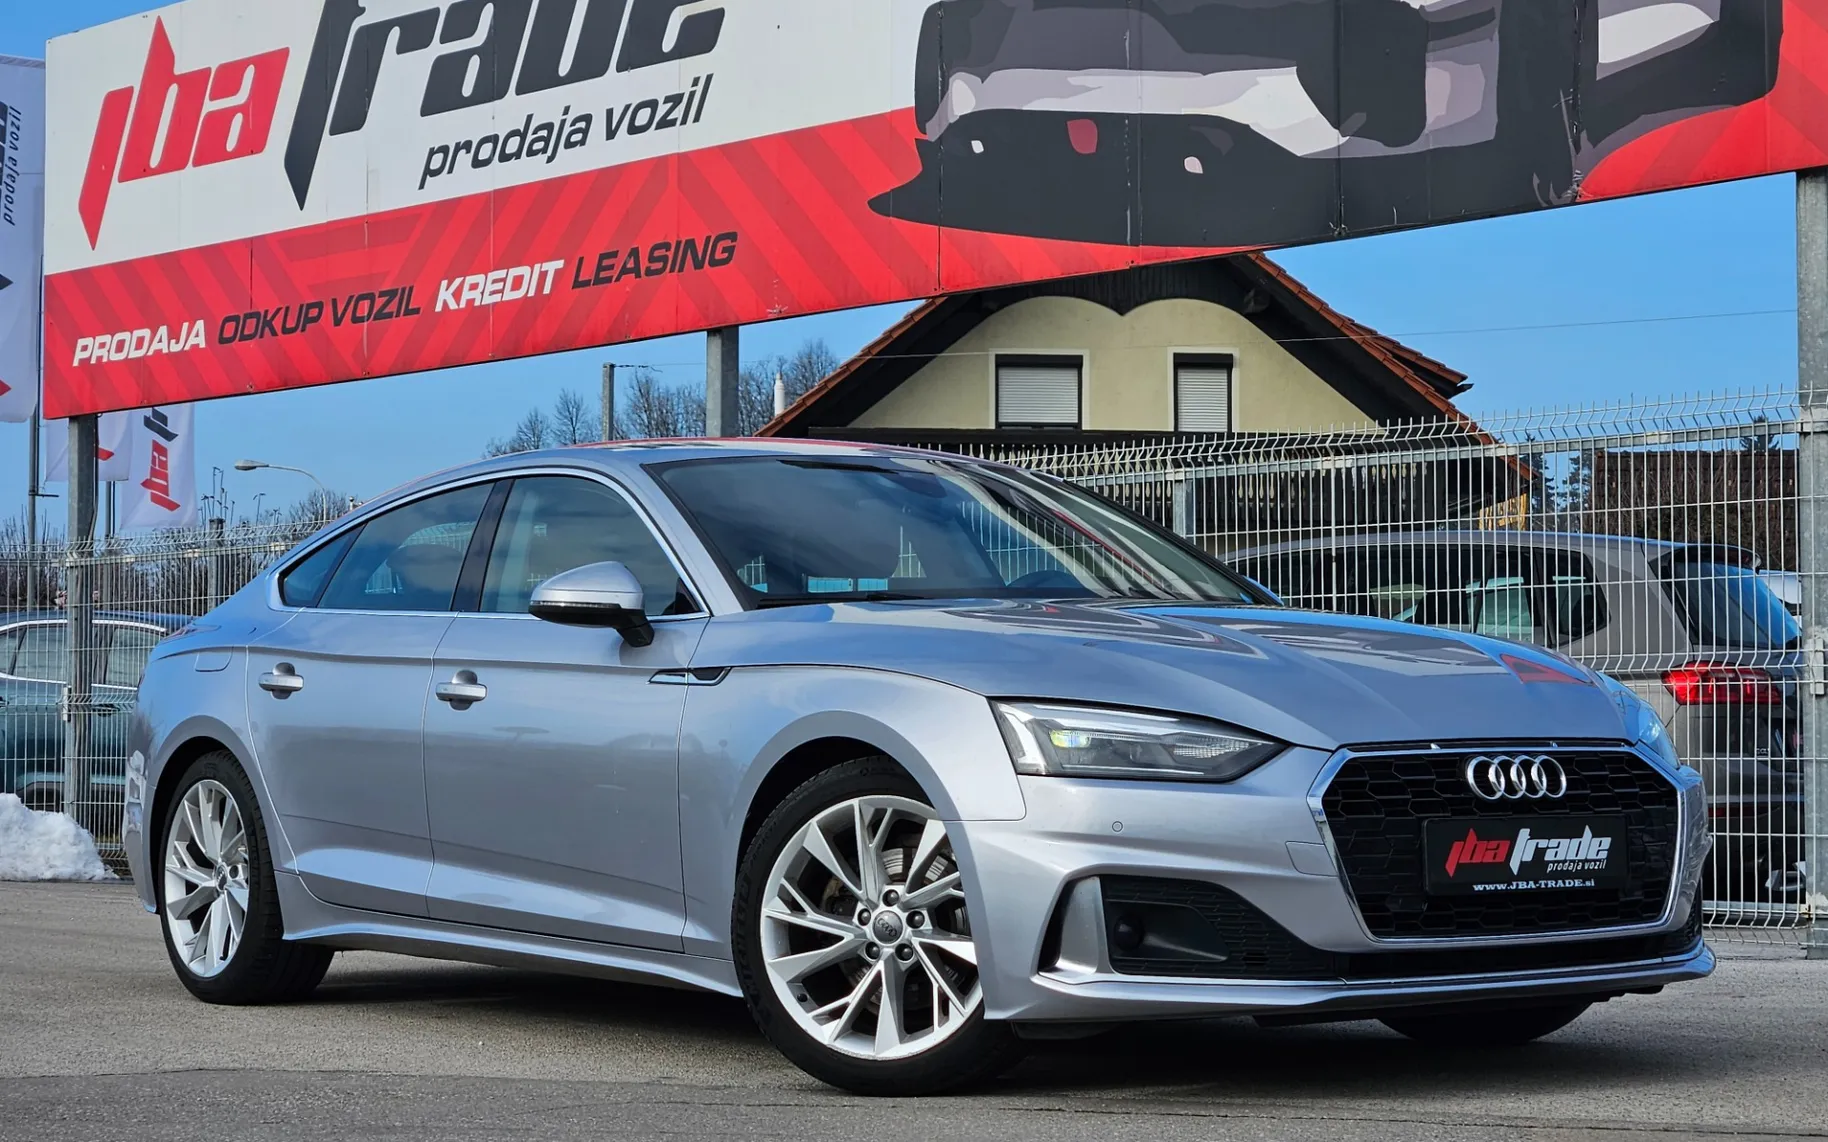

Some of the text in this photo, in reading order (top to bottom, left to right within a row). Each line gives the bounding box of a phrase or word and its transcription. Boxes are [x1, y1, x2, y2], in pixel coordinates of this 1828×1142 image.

[9, 105, 21, 151] vozil
[418, 74, 714, 190] prodaja vozil
[3, 156, 20, 226] prodaja
[72, 231, 738, 367] PRODAJA ODKUP VOZIL KREDIT LEASING
[1509, 825, 1612, 876] trade
[1546, 858, 1607, 873] prodaja vozil
[1472, 879, 1595, 891] www.JBA-TRADE.si
